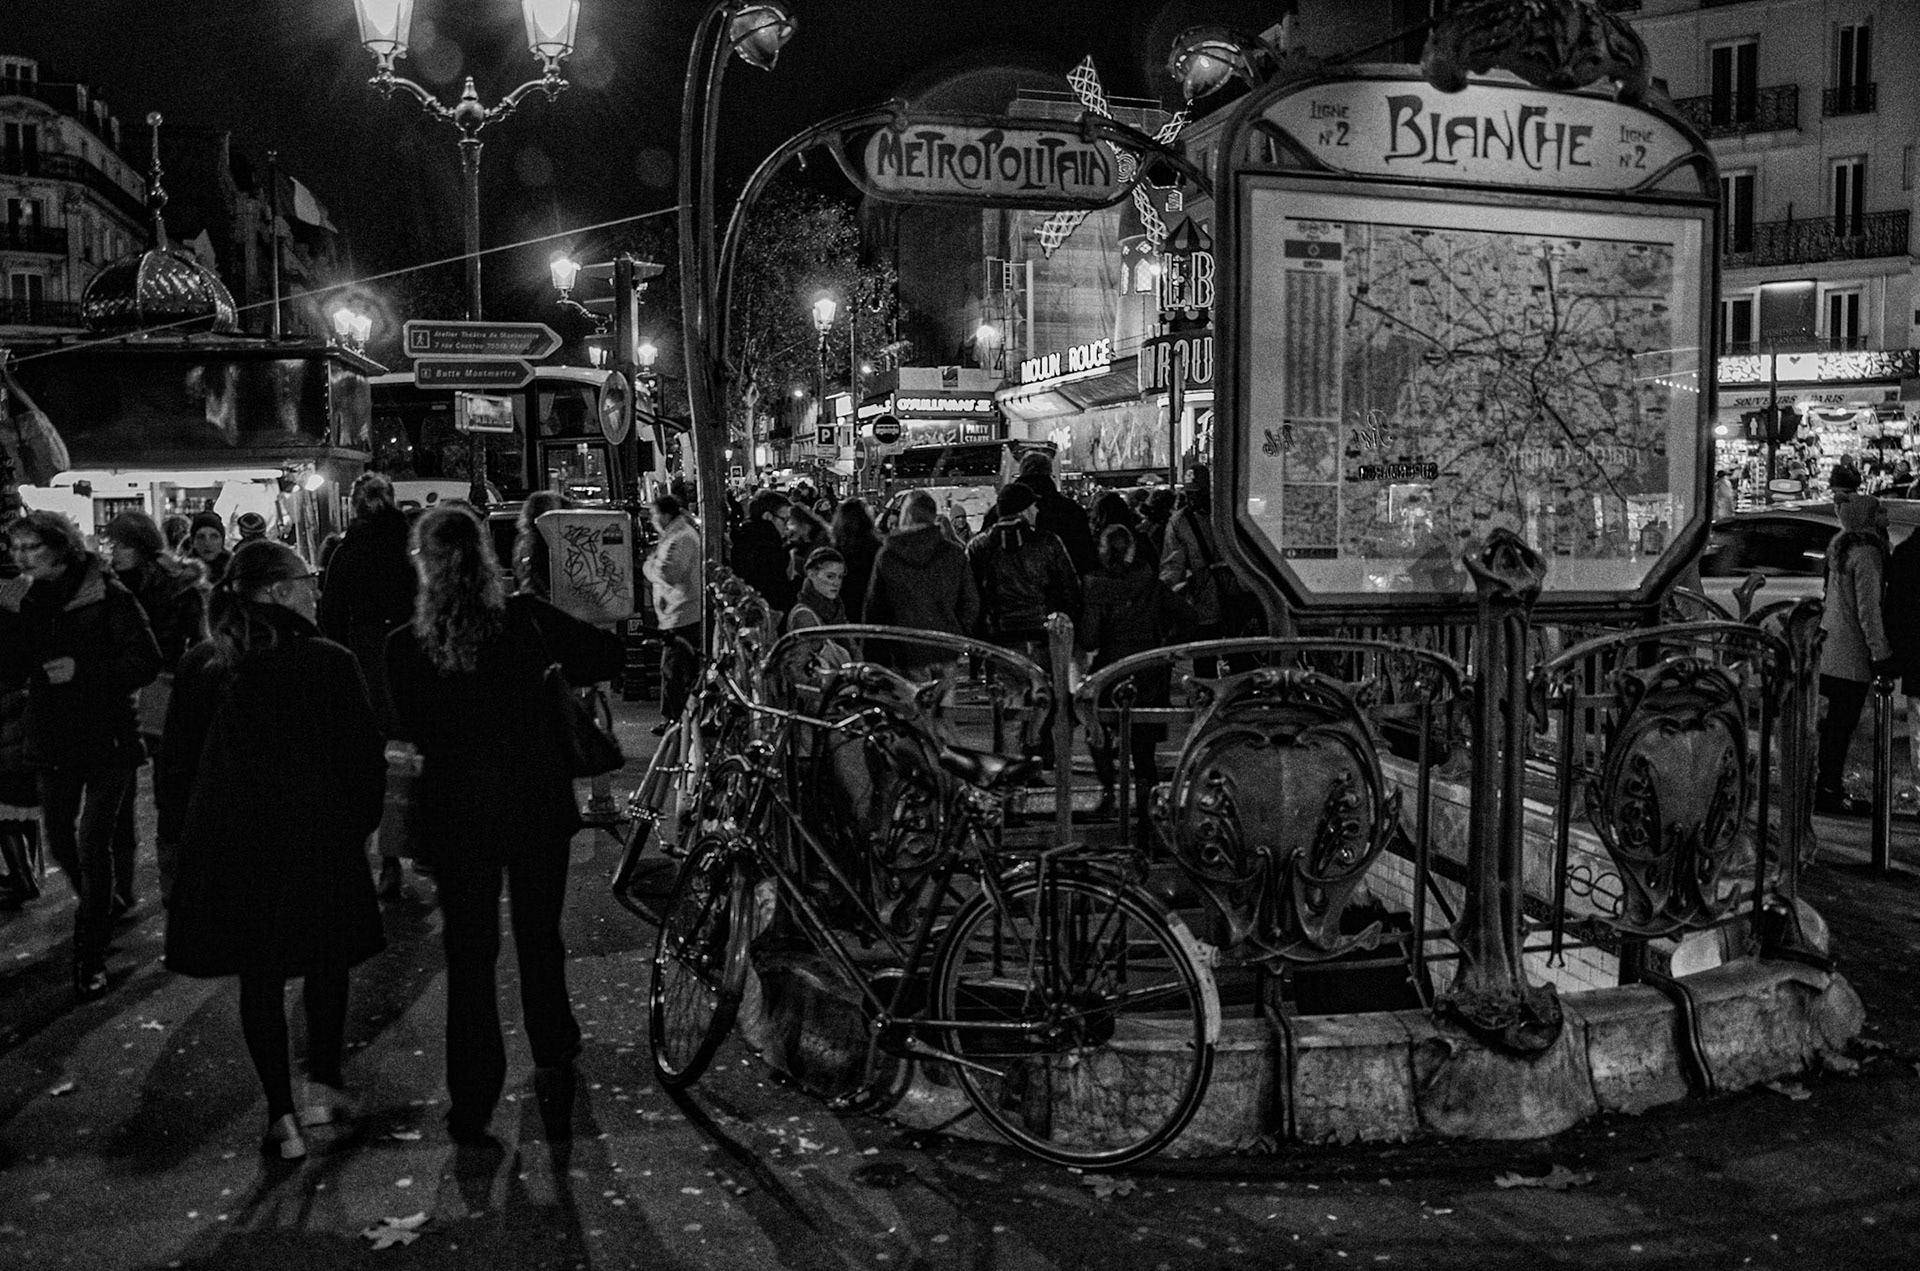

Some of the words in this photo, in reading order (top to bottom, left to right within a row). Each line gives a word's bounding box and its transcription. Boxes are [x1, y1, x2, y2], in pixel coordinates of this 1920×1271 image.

[1336, 121, 1350, 146] 2
[1385, 95, 1593, 171] BLANCHE
[877, 130, 1111, 191] METROPOLITAIN
[1634, 145, 1647, 169] 2
[1021, 352, 1061, 384] MOULIN
[1069, 337, 1111, 372] ROUGE
[435, 369, 461, 377] Butte
[464, 369, 517, 377] Montmartre
[821, 429, 831, 442] P
[965, 424, 988, 434] PARTY
